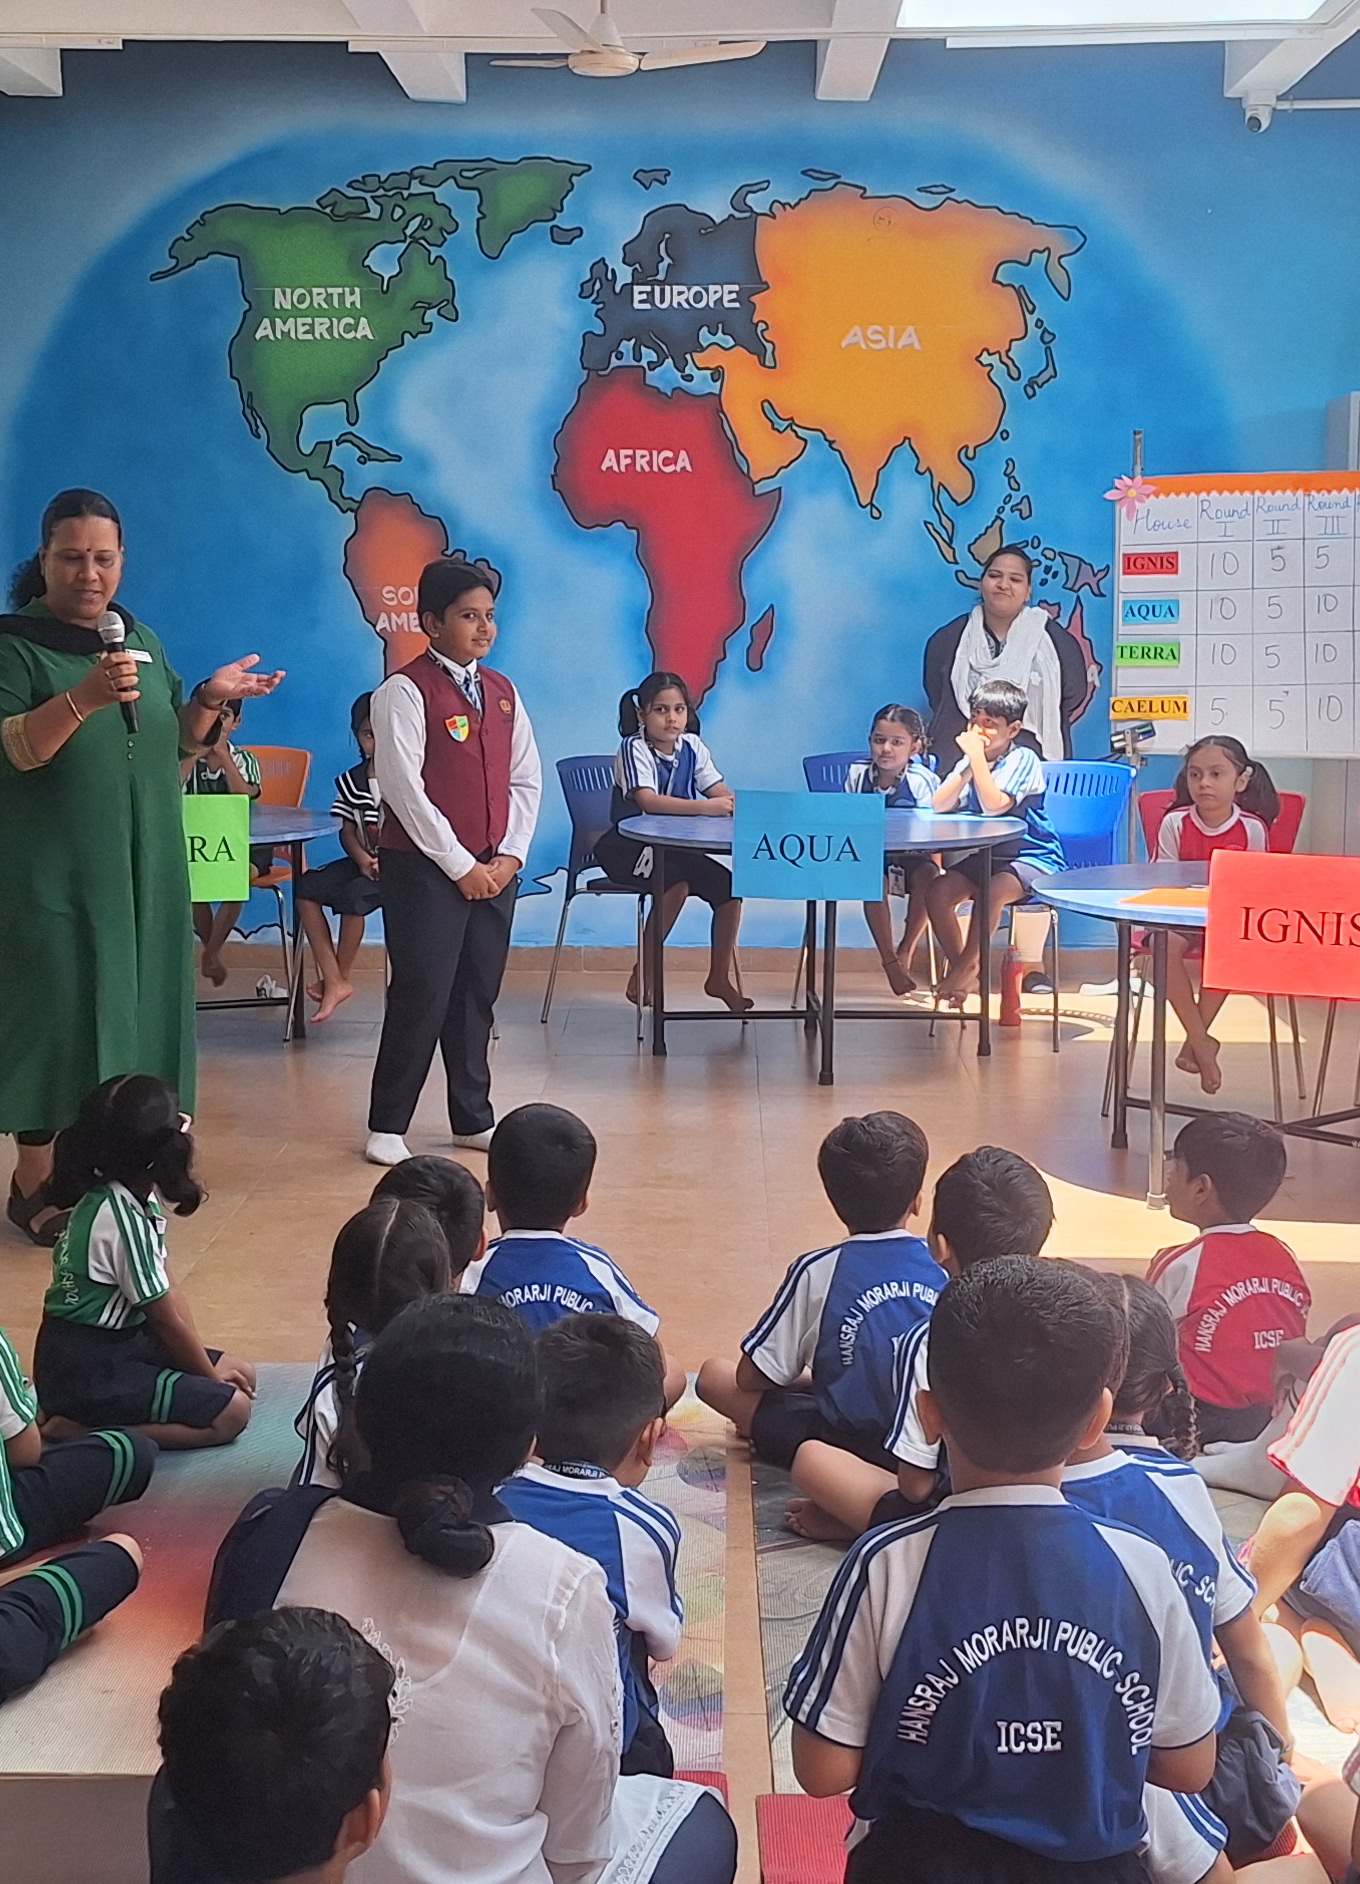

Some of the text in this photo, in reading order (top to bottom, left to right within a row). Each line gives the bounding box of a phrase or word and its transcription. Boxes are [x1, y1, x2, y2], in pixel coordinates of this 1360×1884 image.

[274, 285, 362, 312] NORTH
[632, 282, 741, 311] EUROPE
[255, 314, 375, 342] AMERICA
[841, 325, 922, 351] ASIA
[600, 447, 693, 475] AFRICA
[1133, 508, 1193, 534] House
[1199, 499, 1251, 521] Round
[1254, 496, 1301, 514] Round
[1307, 493, 1351, 511] Round
[1125, 556, 1177, 571] IGNIS
[1209, 551, 1239, 580] 10
[1270, 547, 1287, 571] 5
[1315, 547, 1330, 570] 5
[1124, 603, 1176, 621] AQUA
[1209, 596, 1237, 621] 10
[1267, 595, 1284, 620] 5
[1317, 593, 1338, 615] 10
[1117, 645, 1178, 661] TERRA
[1211, 642, 1237, 666] 10
[1265, 645, 1281, 669] 5
[1314, 642, 1338, 664] 10
[1111, 699, 1189, 716] CAELUM
[1210, 697, 1227, 726] 5
[1269, 698, 1286, 729] 5
[1318, 696, 1343, 722] 10
[752, 833, 861, 869] AQUA
[552, 1285, 594, 1314] PUBLIC
[1194, 1277, 1304, 1353] HANSRAJ MORARJI PUBLIC
[839, 1307, 864, 1366] HANSRAJ
[856, 1280, 911, 1313] MORARJI
[896, 1616, 1155, 1756] HANSRAJ MORARJI PUBLIC SCHOOL
[996, 1720, 1062, 1754] ICSE
